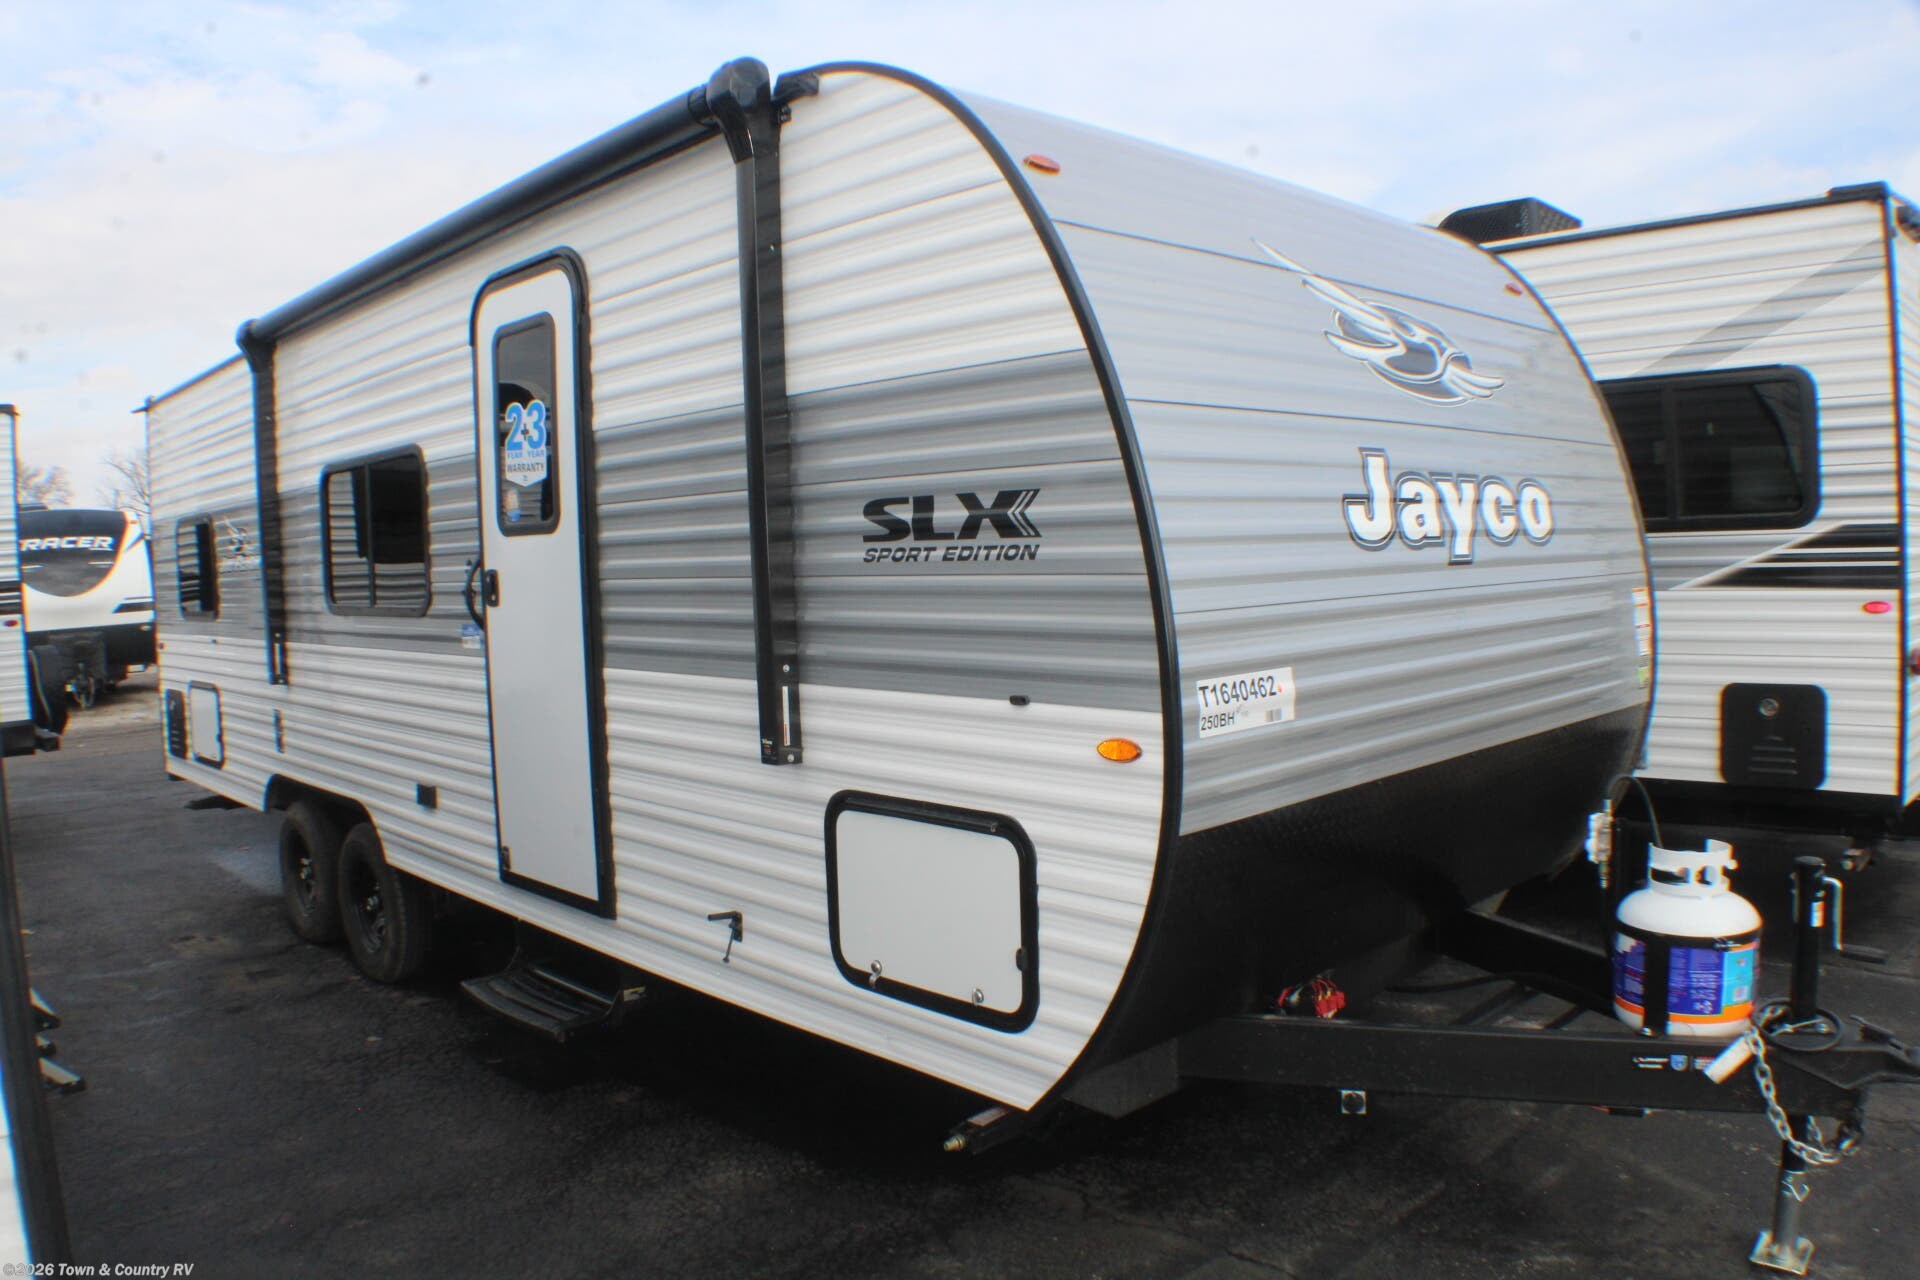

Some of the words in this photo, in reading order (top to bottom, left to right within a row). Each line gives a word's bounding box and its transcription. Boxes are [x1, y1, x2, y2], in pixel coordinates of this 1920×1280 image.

[527, 450, 545, 458] YEAR
[507, 462, 545, 473] WARRANTY
[862, 488, 1042, 542] SLX
[1342, 447, 1555, 566] Jayco
[18, 535, 115, 551] RACER
[863, 546, 937, 563] SPORT
[942, 544, 1041, 562] EDITION
[1198, 675, 1277, 708] T1640462
[1201, 711, 1235, 731] 250BH
